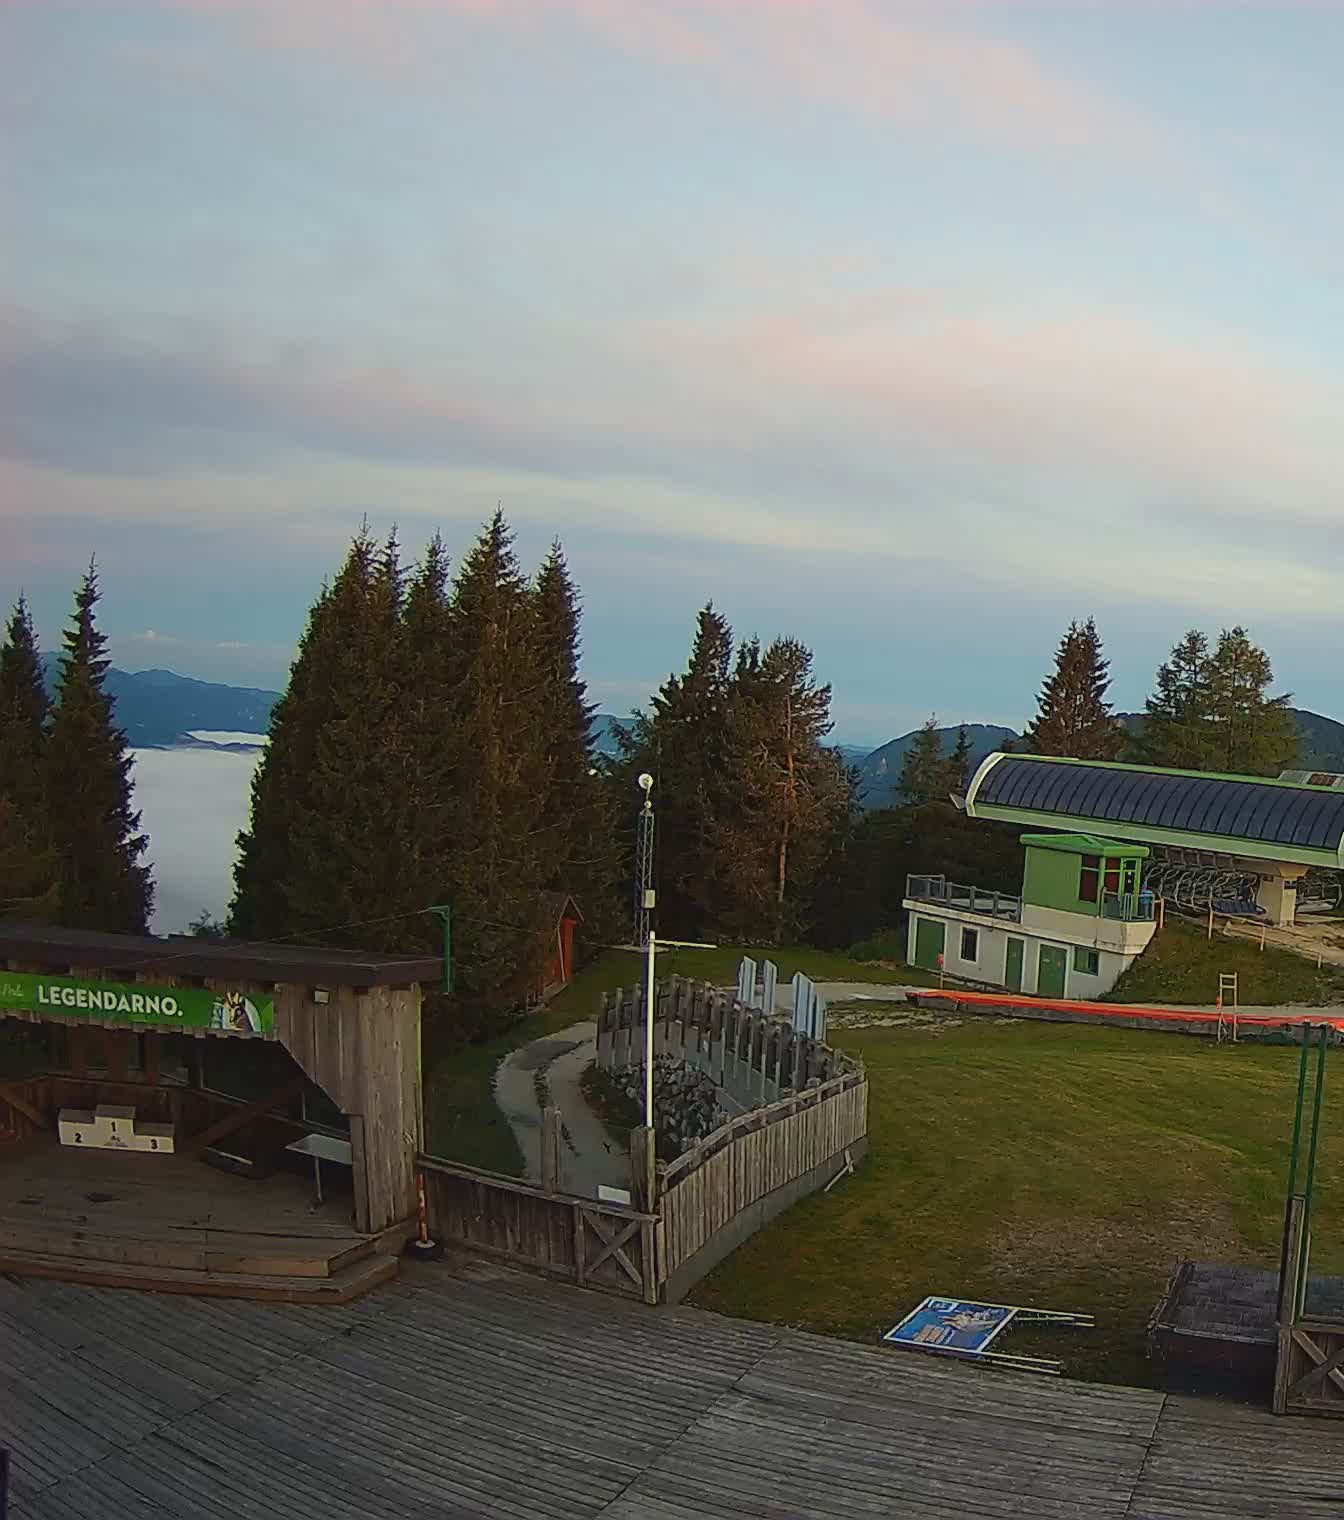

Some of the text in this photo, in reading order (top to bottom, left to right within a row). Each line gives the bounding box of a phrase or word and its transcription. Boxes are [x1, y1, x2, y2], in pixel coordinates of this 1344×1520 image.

[38, 984, 183, 1017] LEGENDARNO.
[111, 1121, 117, 1133] 1
[74, 1132, 82, 1144] 2
[150, 1138, 158, 1150] 3
